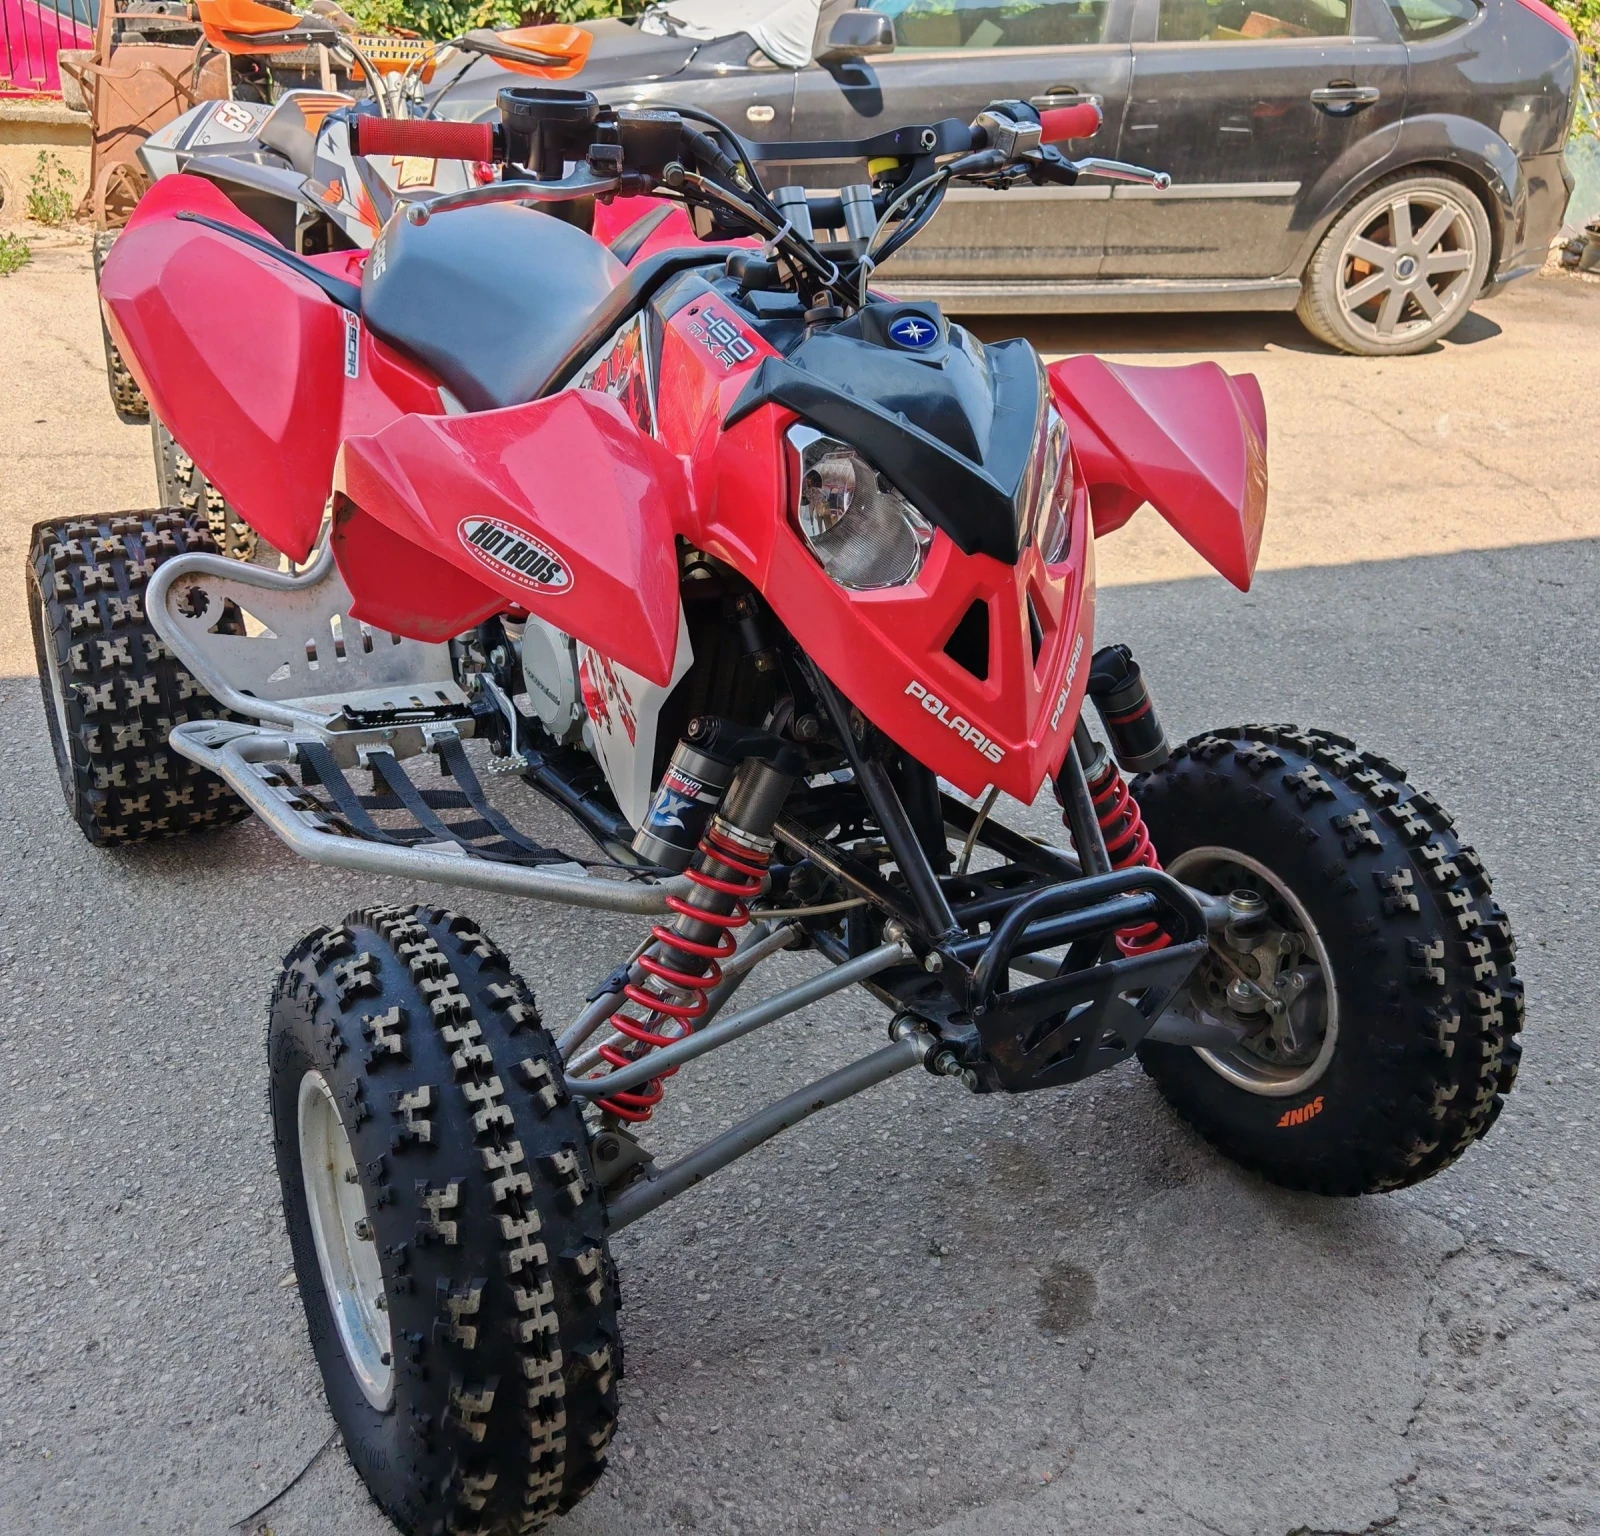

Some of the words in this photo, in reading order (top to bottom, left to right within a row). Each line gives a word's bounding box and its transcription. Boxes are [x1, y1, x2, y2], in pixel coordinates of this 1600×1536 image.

[358, 38, 428, 49] RENTHAL
[362, 50, 427, 60] RENTHA
[214, 101, 256, 133] 68
[347, 325, 359, 376] SCAR
[701, 307, 756, 362] 450
[467, 521, 515, 556] HOT
[501, 541, 562, 584] RODS
[490, 519, 508, 530] THE
[512, 529, 558, 560] ORIGINAL
[473, 547, 500, 569] CRANKS
[501, 567, 517, 579] AND
[518, 576, 540, 588] RODS
[1050, 632, 1084, 732] POLARIS
[904, 680, 1006, 764] POLARIS
[668, 768, 703, 790] PODIUM
[1276, 1095, 1325, 1127] SUNF
